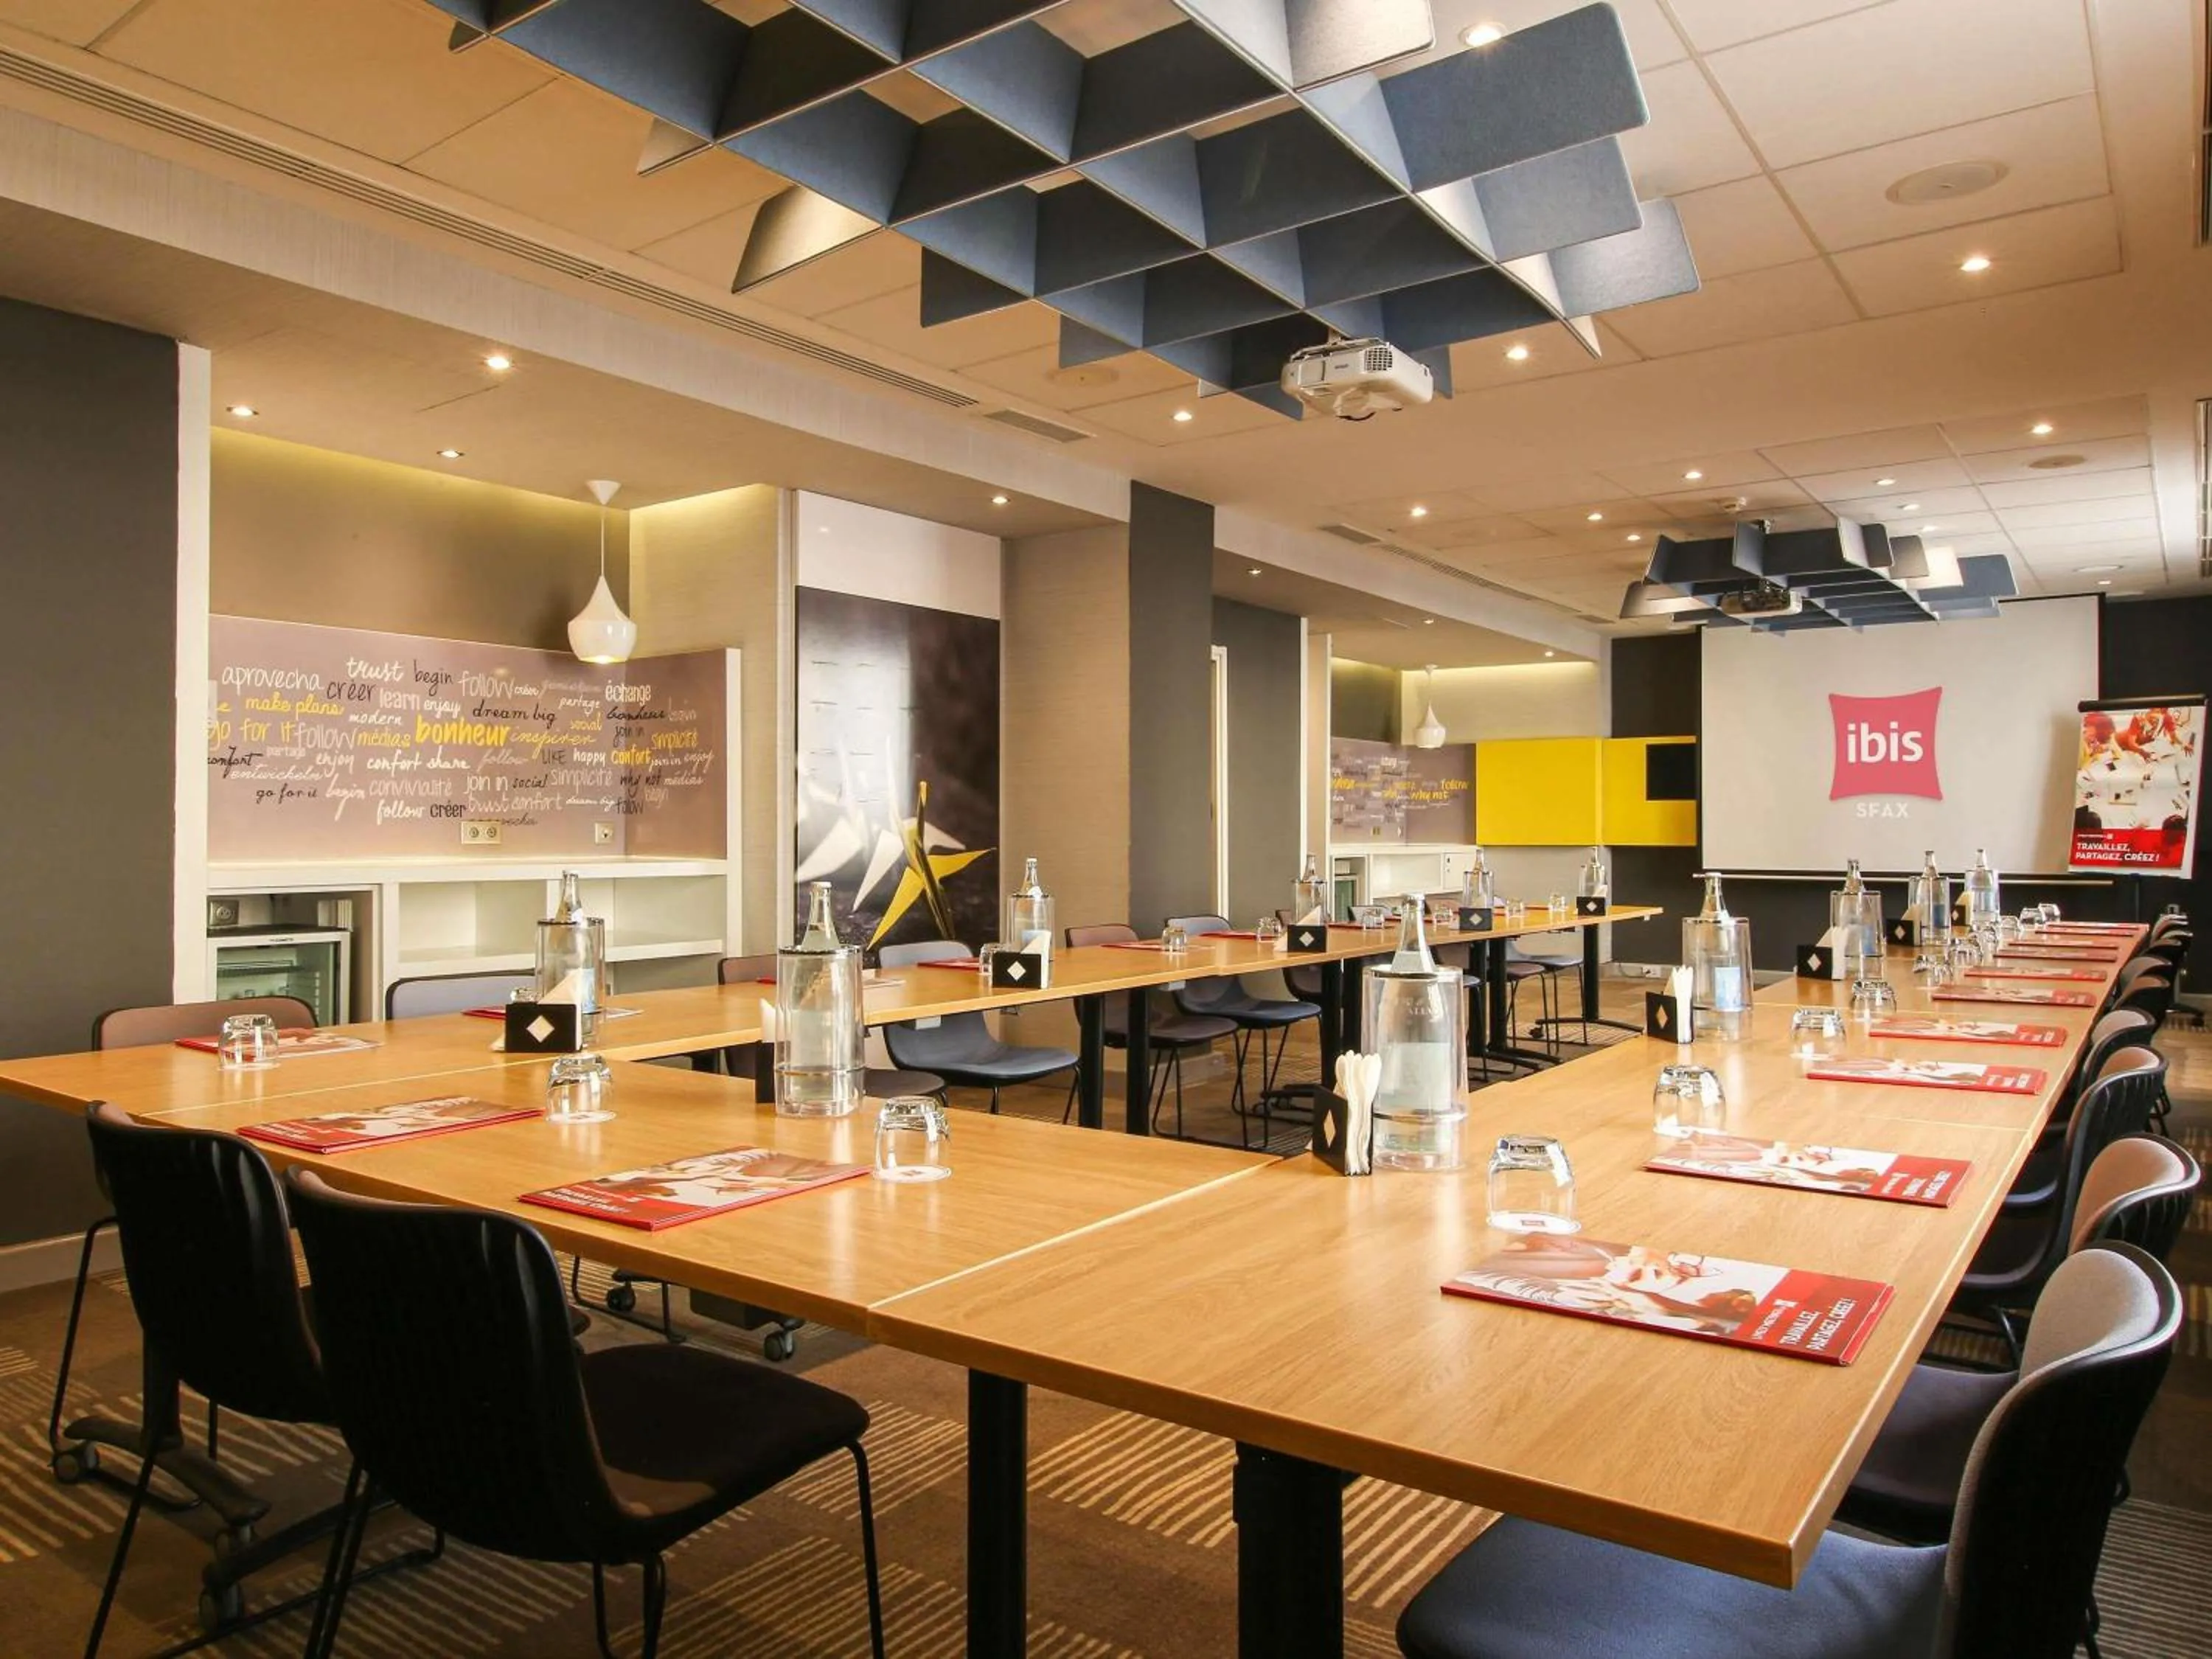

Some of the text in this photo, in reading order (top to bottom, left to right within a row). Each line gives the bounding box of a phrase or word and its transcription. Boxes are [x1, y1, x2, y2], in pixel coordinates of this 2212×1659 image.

[221, 666, 324, 696] aprovecha
[346, 656, 404, 682] trust
[413, 659, 454, 697] begin
[457, 669, 515, 700] follow
[605, 680, 651, 706] échange
[246, 691, 291, 713] make
[379, 687, 420, 711] learn
[423, 699, 461, 718] enjoy
[348, 708, 403, 726] modern
[473, 699, 557, 729] dream big
[239, 718, 272, 742] for
[295, 721, 358, 750] follow
[356, 726, 411, 748] médias
[414, 714, 511, 747] bonheur
[1846, 720, 1924, 764] ibis
[316, 751, 355, 778] enjoy
[366, 748, 422, 777] confort
[426, 744, 471, 770] share
[573, 747, 607, 768] happy
[611, 742, 653, 769] confort
[255, 789, 276, 804] go
[277, 782, 305, 804] for
[512, 773, 549, 790] social
[325, 773, 366, 821] begin
[429, 799, 467, 818] créer
[510, 790, 565, 812] confort
[1855, 801, 1909, 818] SFAX
[376, 799, 426, 827] follow
